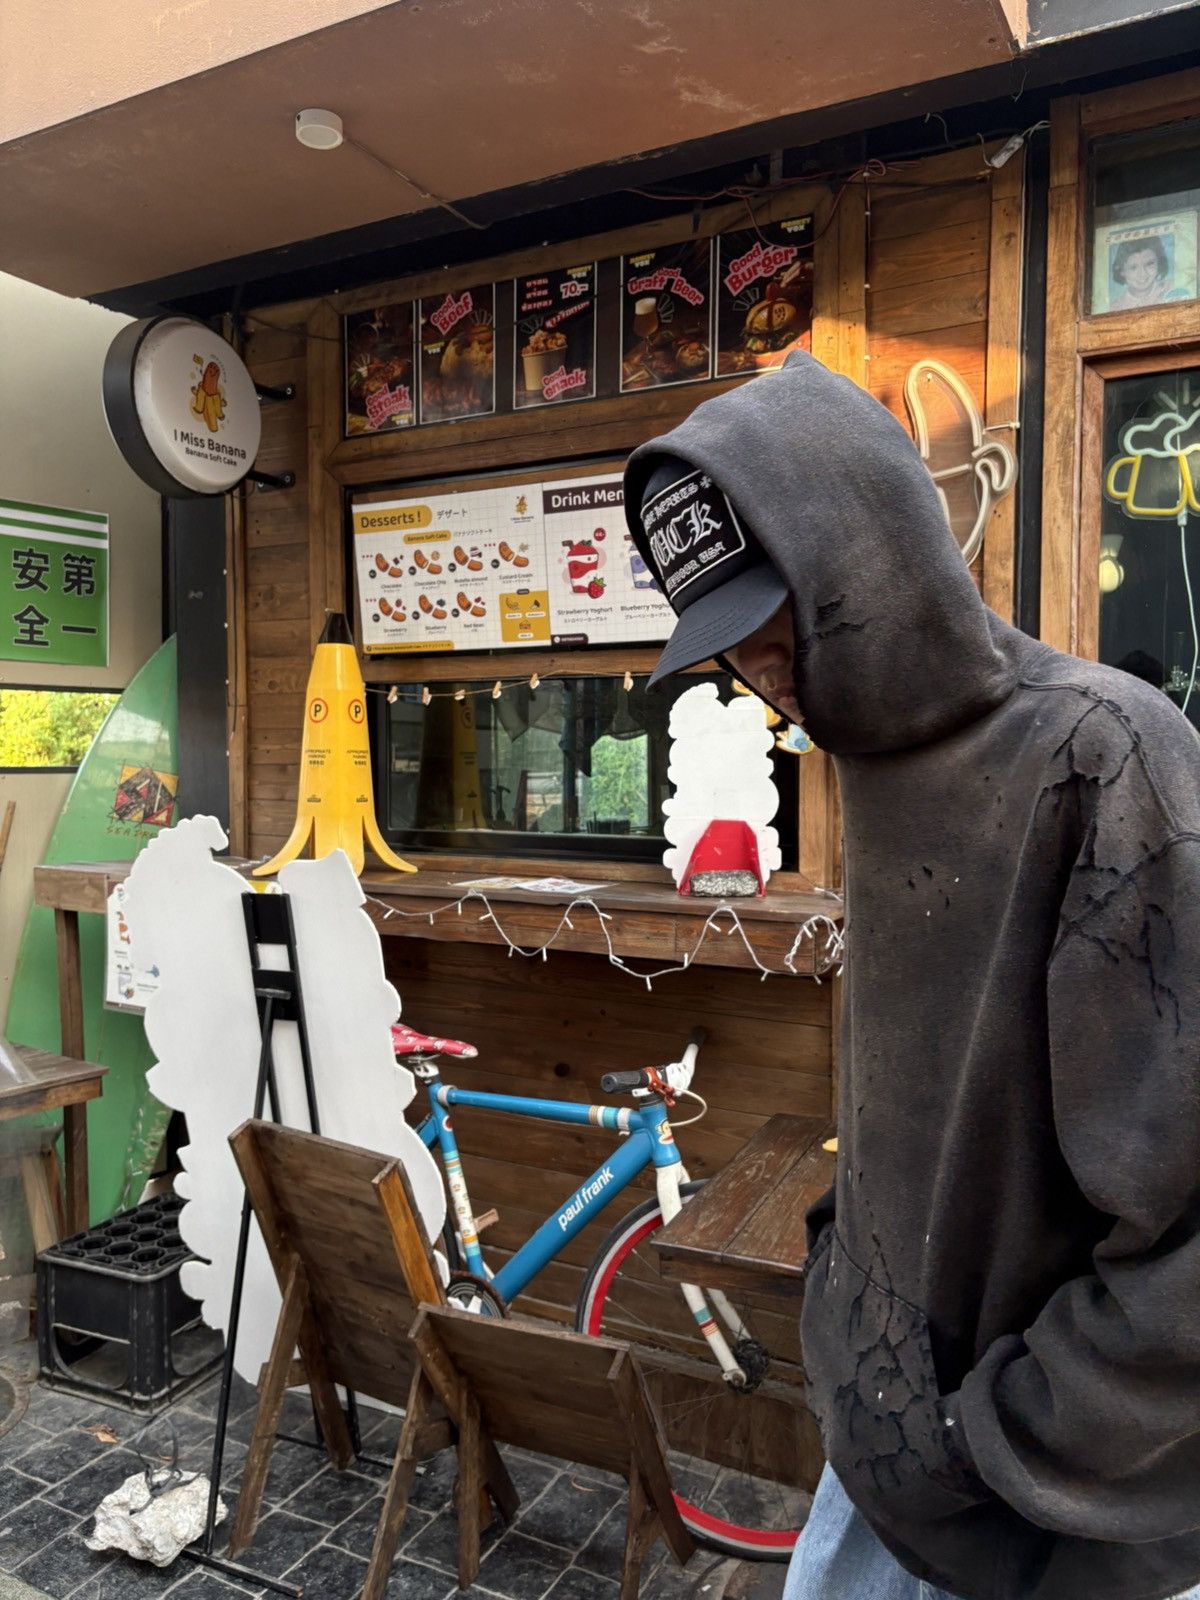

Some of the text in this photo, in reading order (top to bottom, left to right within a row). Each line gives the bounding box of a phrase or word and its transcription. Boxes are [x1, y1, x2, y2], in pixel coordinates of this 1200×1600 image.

[730, 243, 761, 273] Good
[726, 248, 797, 295] Burger
[628, 275, 704, 304] Craft Beer
[432, 295, 455, 325] Good
[543, 366, 566, 385] Good
[173, 429, 247, 460] I Miss Banana
[185, 447, 237, 466] Banana Soft Cake
[551, 491, 591, 508] Drink
[360, 512, 415, 528] Desserts
[590, 606, 613, 615] Yoghurt
[620, 604, 650, 612] Blueberry
[314, 703, 322, 718] P
[354, 704, 361, 718] P
[558, 1166, 615, 1232] paul frank
